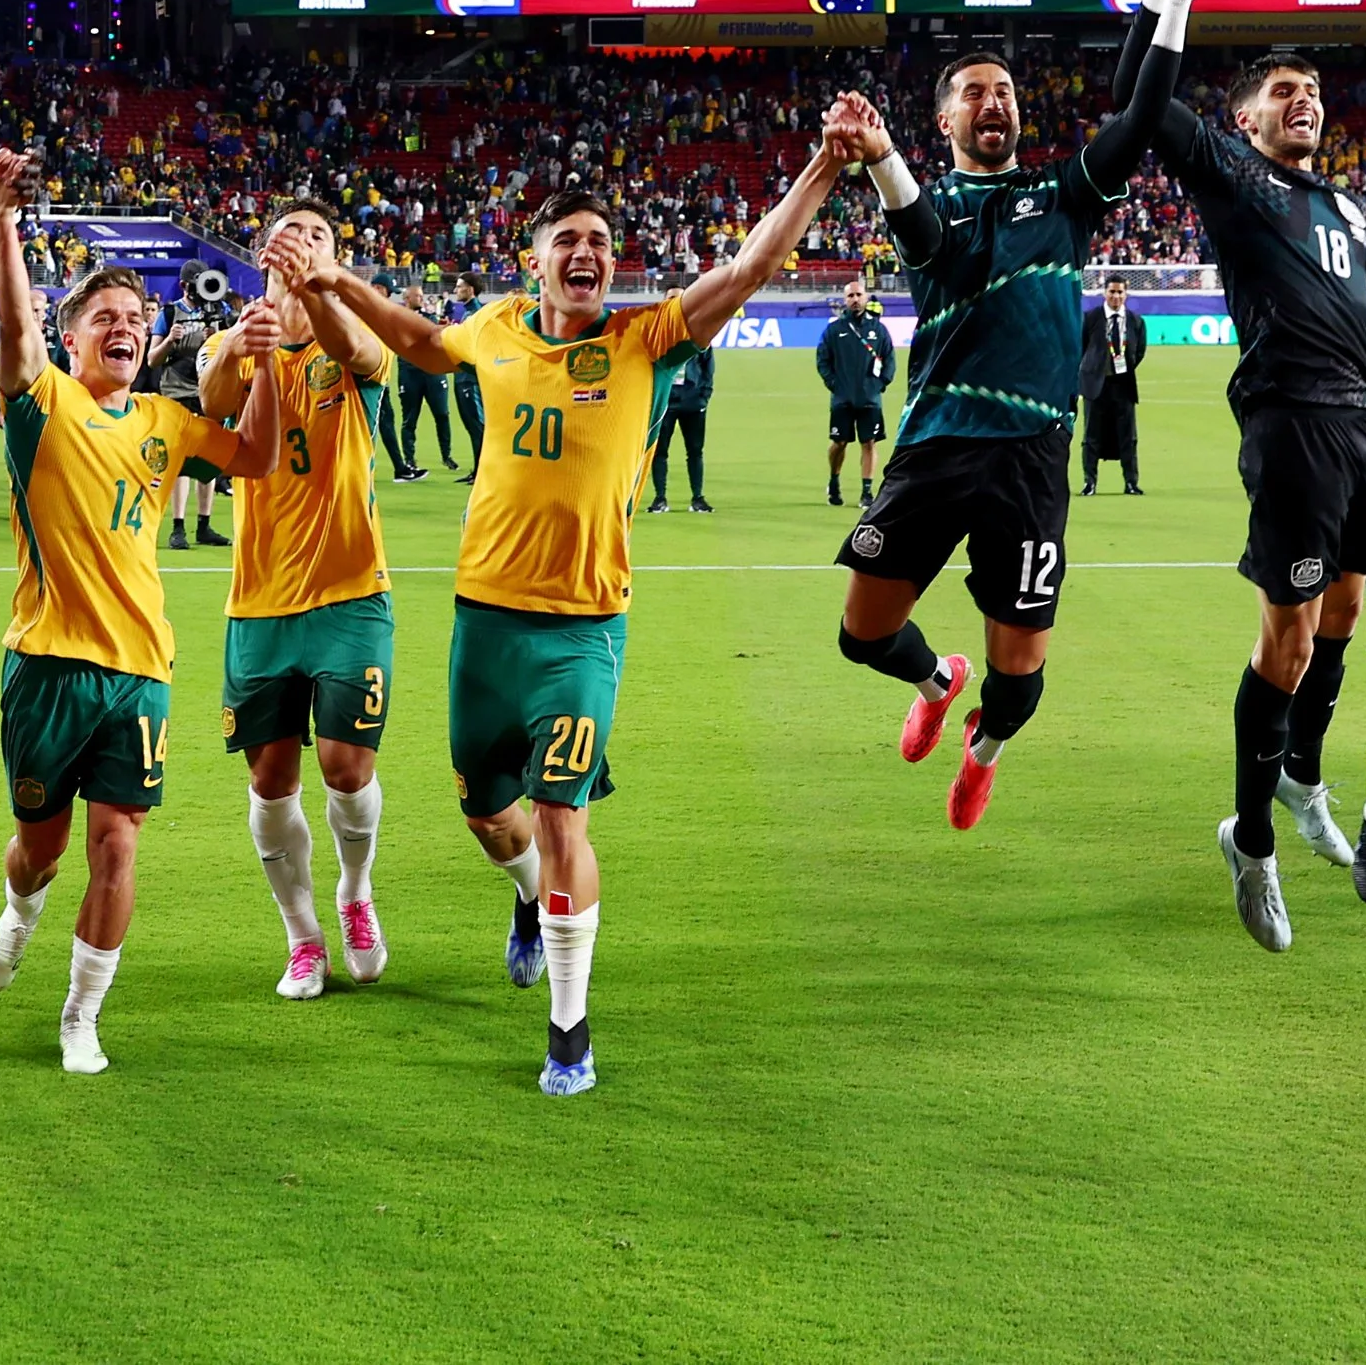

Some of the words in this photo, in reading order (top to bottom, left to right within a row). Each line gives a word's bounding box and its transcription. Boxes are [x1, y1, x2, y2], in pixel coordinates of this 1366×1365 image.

[718, 21, 814, 38] #FIFAWorldCup
[1199, 24, 1232, 34] SAN
[1237, 24, 1328, 34] FRANCISCO
[1333, 24, 1361, 34] BAY
[1011, 210, 1043, 222] AUSTRALIA
[154, 240, 182, 248] AREA
[1314, 224, 1351, 279] 18
[287, 427, 313, 475] 3
[512, 403, 563, 461] 20
[110, 479, 144, 536] 14
[1019, 540, 1058, 596] 12
[365, 666, 384, 717] 3
[138, 716, 167, 771] 14
[544, 715, 596, 772] 20
